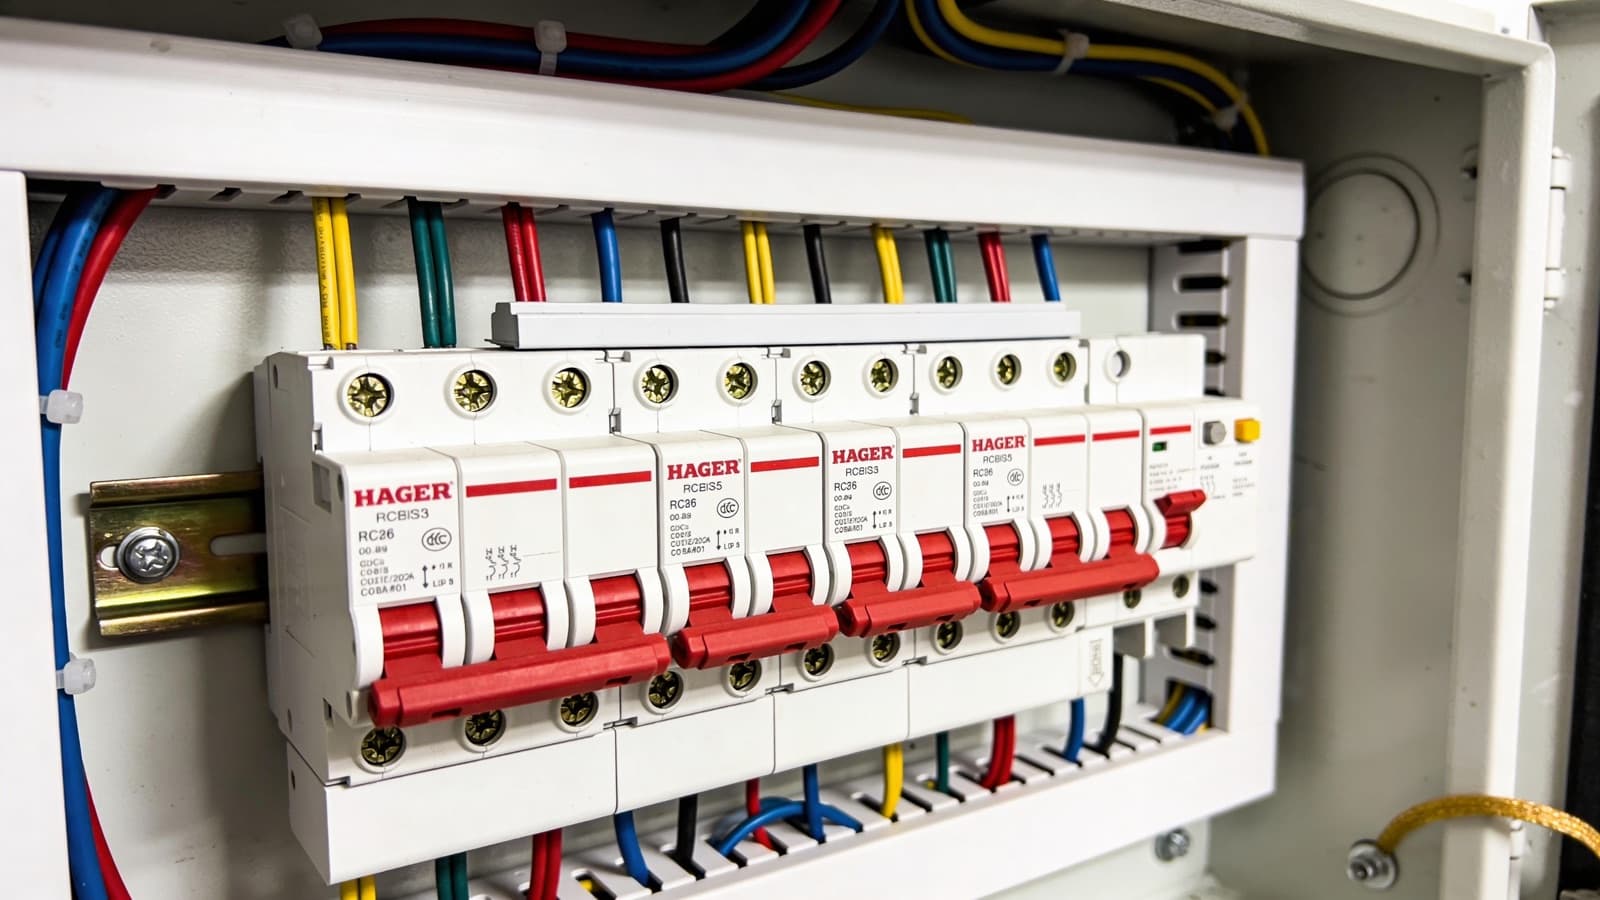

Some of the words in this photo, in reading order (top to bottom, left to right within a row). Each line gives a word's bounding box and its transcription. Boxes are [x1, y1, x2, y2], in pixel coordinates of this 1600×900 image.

[971, 435, 1026, 452] HAGER
[831, 446, 894, 464] HAGER
[667, 459, 740, 480] HAGER
[353, 482, 452, 507] HAGER
[376, 507, 429, 524] RCBIS3
